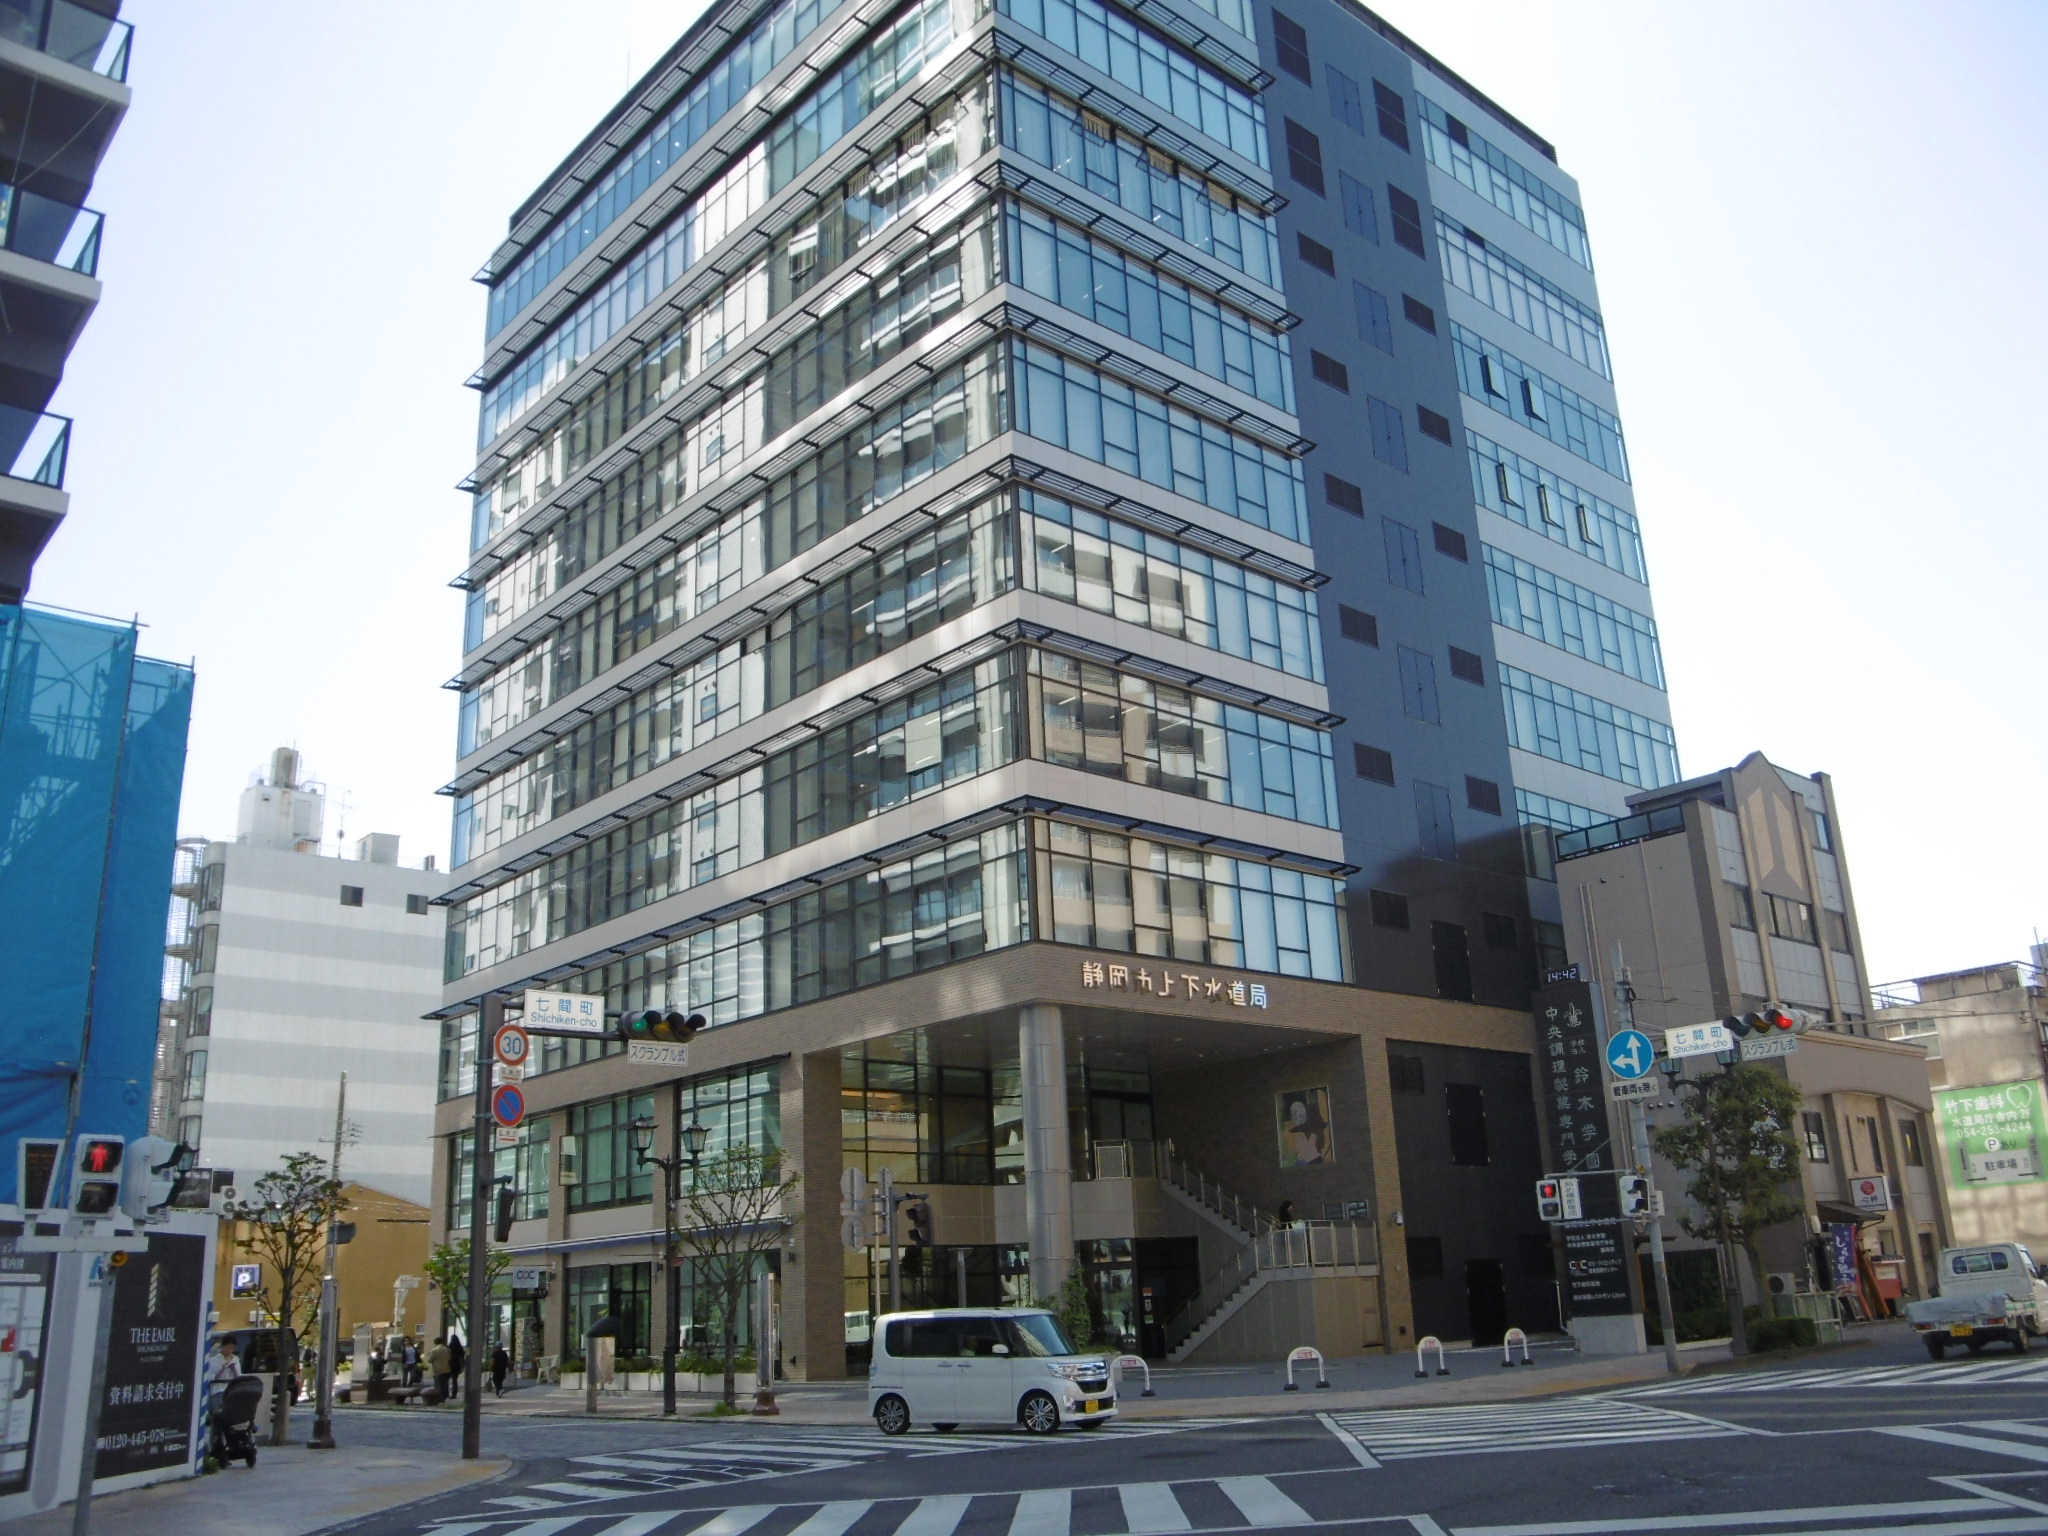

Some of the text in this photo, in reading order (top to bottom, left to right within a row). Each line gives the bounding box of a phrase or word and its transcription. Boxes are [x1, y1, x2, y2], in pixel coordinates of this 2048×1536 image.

[1082, 960, 1267, 1009] 静岡市上下水道局
[1547, 967, 1577, 983] 14:42
[536, 997, 593, 1016] 七間町
[530, 1012, 597, 1028] Shichiken-cho
[502, 1035, 522, 1055] 30
[1675, 1026, 1722, 1045] 七間町
[630, 1044, 686, 1063] スクランブル式
[1673, 1040, 1728, 1055] Shichiken-cho
[1743, 1037, 1796, 1057] スクランブル式
[1944, 1093, 2005, 1114] 竹下歯科
[1957, 1120, 2032, 1138] 054-253-4244
[109, 1381, 184, 1406] 資料請求受付中
